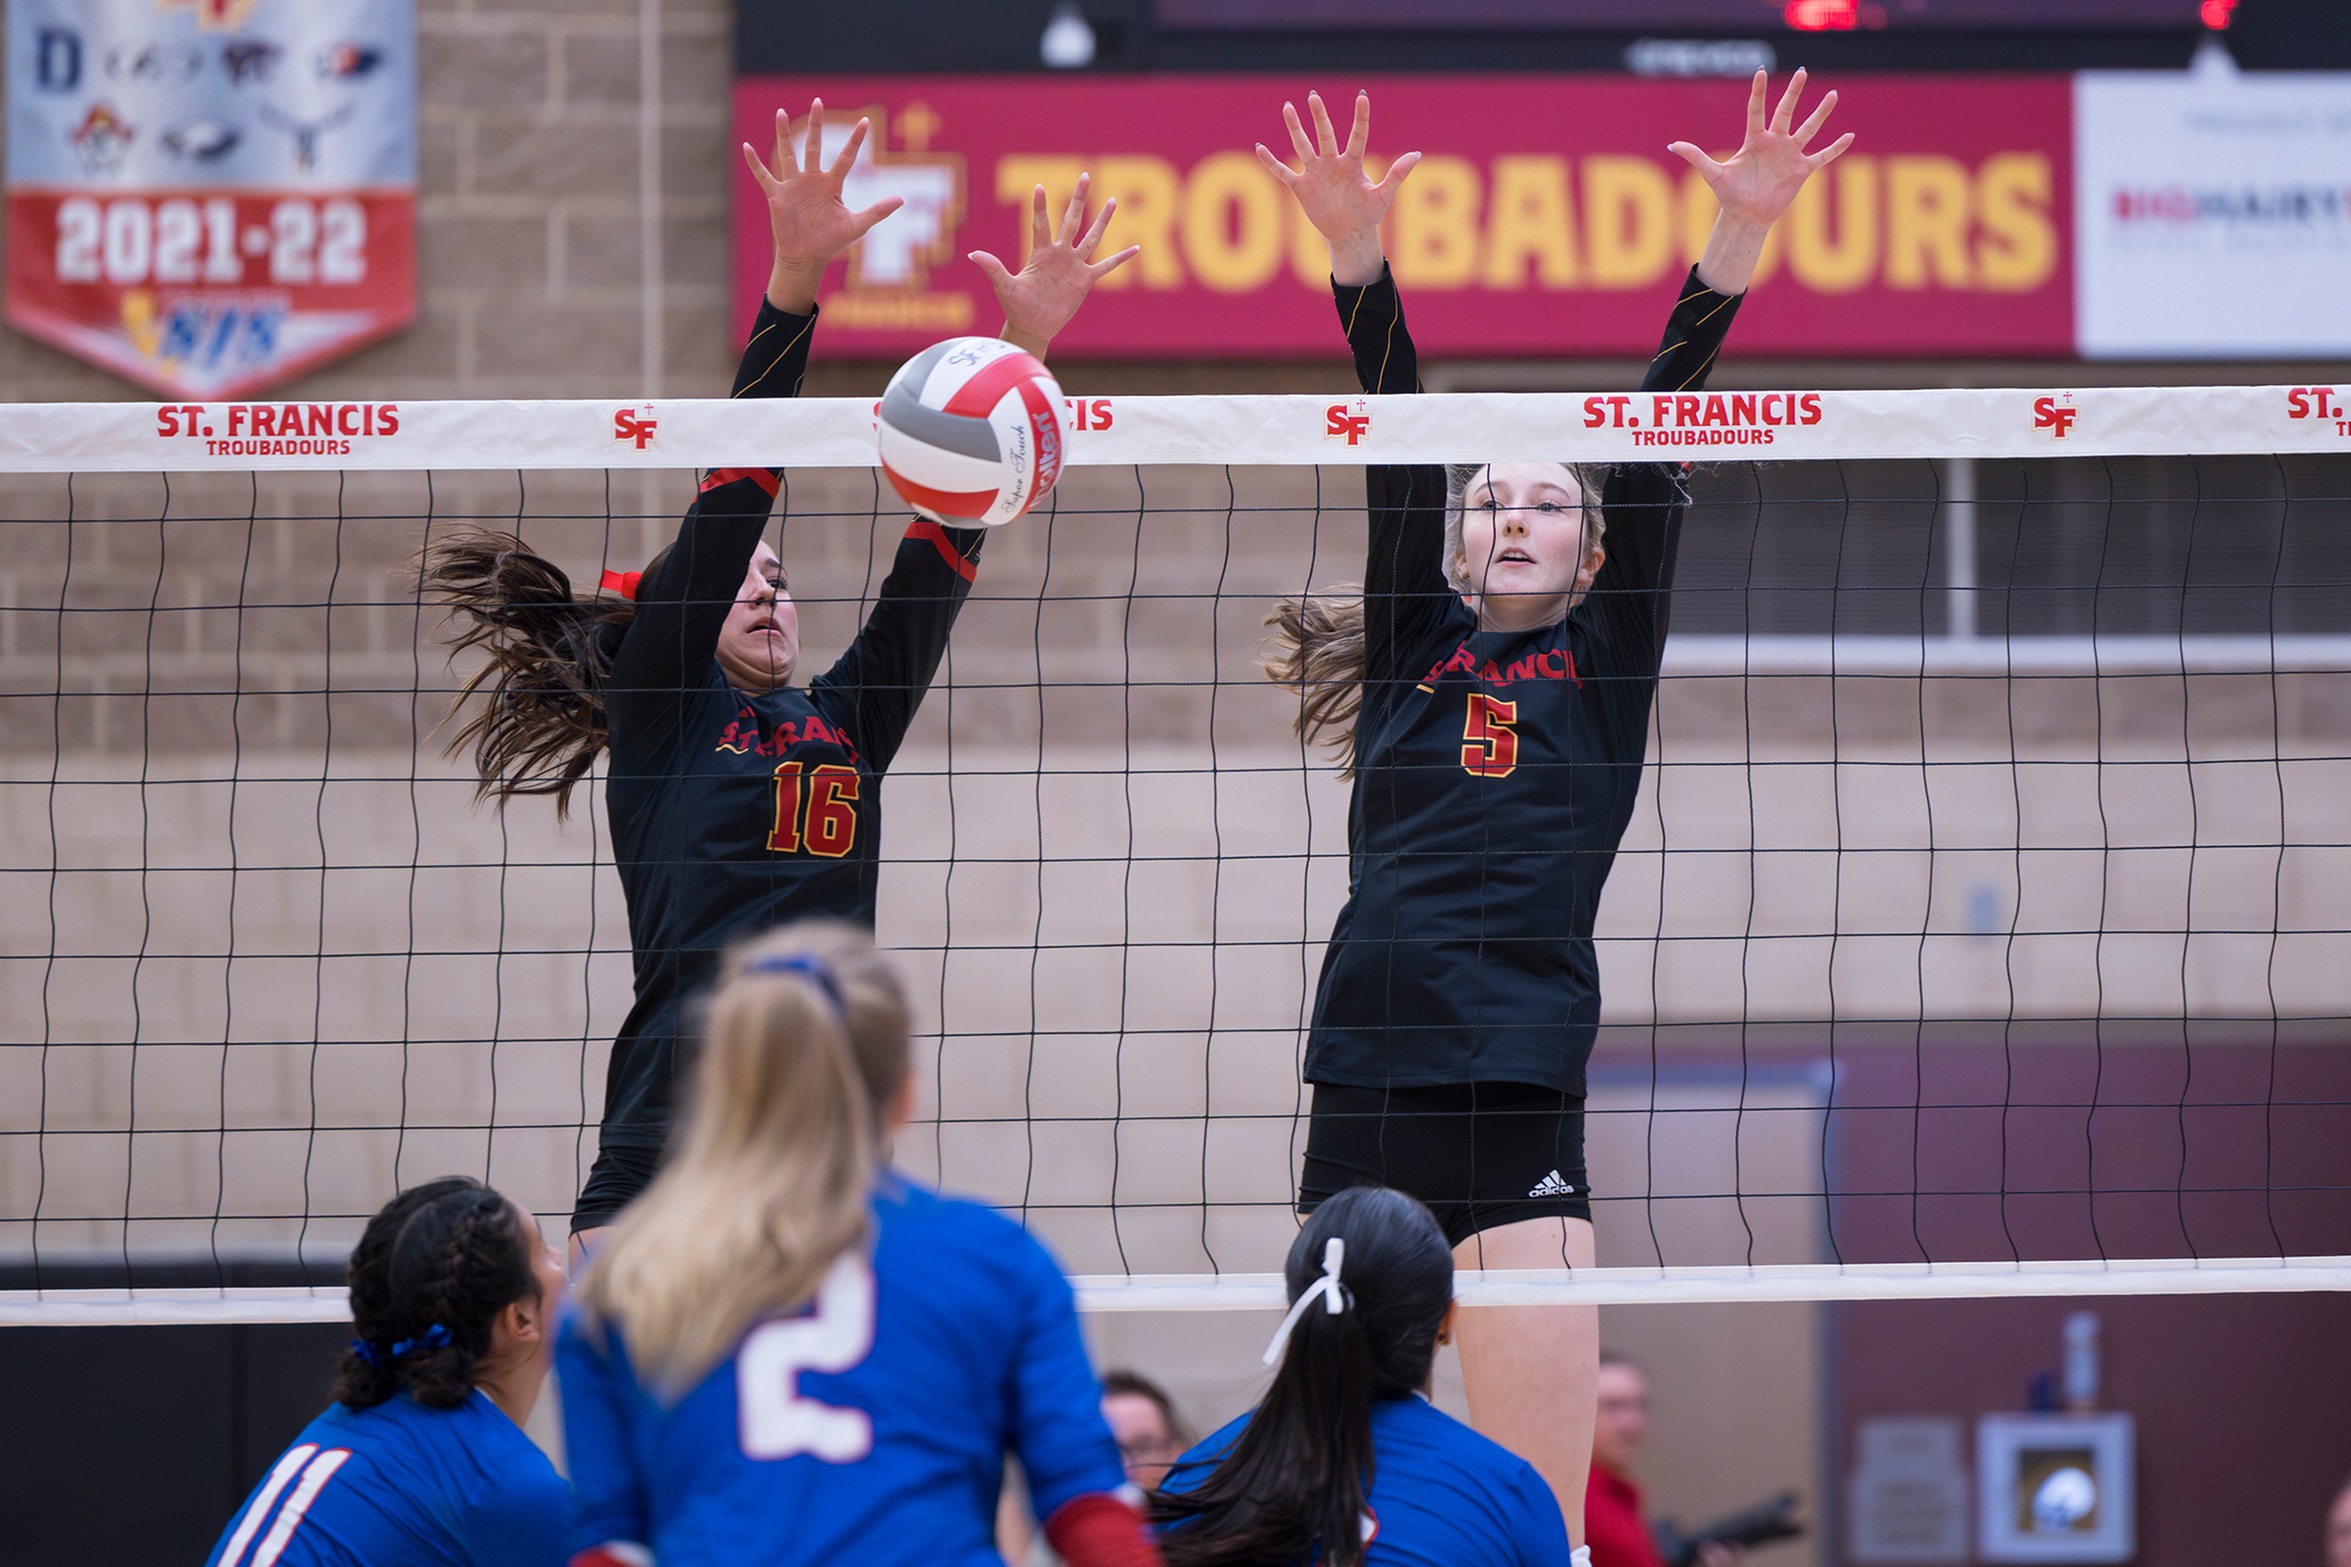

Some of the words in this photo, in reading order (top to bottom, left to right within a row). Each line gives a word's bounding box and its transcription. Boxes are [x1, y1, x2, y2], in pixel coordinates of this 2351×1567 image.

[55, 198, 366, 284] 2021-22
[157, 405, 214, 438] ST.
[227, 403, 399, 438] FRANCIS
[1325, 403, 1371, 447] SF
[1583, 396, 1640, 429] ST.
[1653, 393, 1822, 428] FRANCIS
[2032, 395, 2078, 439] SF
[2287, 387, 2343, 419] ST.
[206, 439, 351, 456] TROUBADOURS
[613, 407, 659, 451] SF
[1010, 424, 1026, 473] Touch
[1631, 429, 1775, 447] TROUBADOURS
[1029, 411, 1057, 509] molten
[1001, 476, 1024, 513] Super
[1461, 693, 1519, 778] 5
[766, 761, 860, 858] 16
[1528, 1184, 1575, 1198] adidas
[736, 1252, 877, 1465] 2
[217, 1442, 353, 1567] 11
